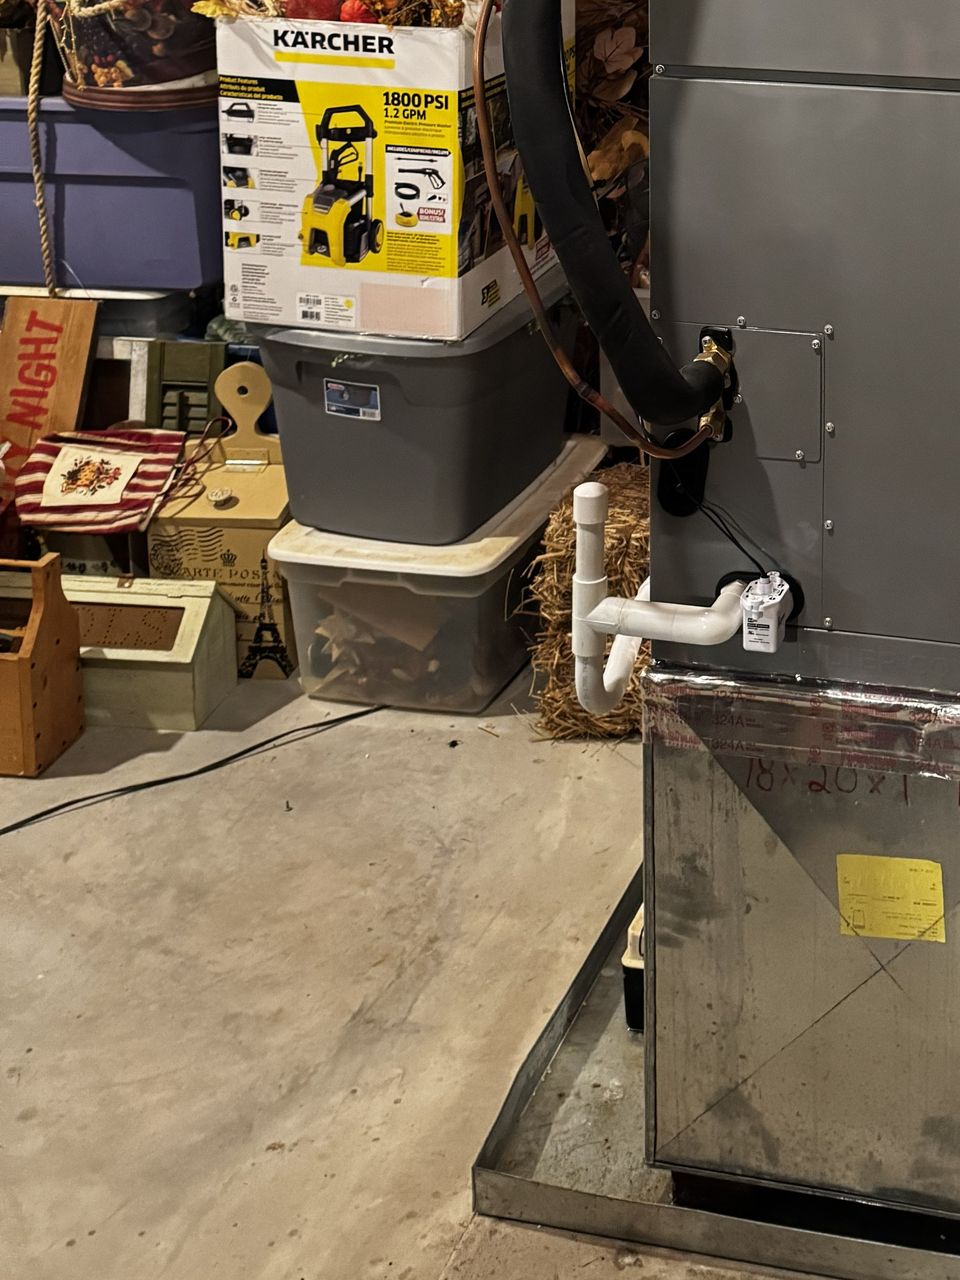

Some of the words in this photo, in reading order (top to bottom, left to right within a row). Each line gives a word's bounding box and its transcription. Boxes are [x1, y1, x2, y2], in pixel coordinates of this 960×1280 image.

[273, 29, 395, 54] KÄRCHER
[383, 91, 422, 108] 1800
[424, 94, 448, 110] PSI
[384, 107, 400, 118] 1.2
[402, 108, 426, 120] GPM
[420, 207, 444, 215] BONUS!
[808, 764, 858, 794] 20
